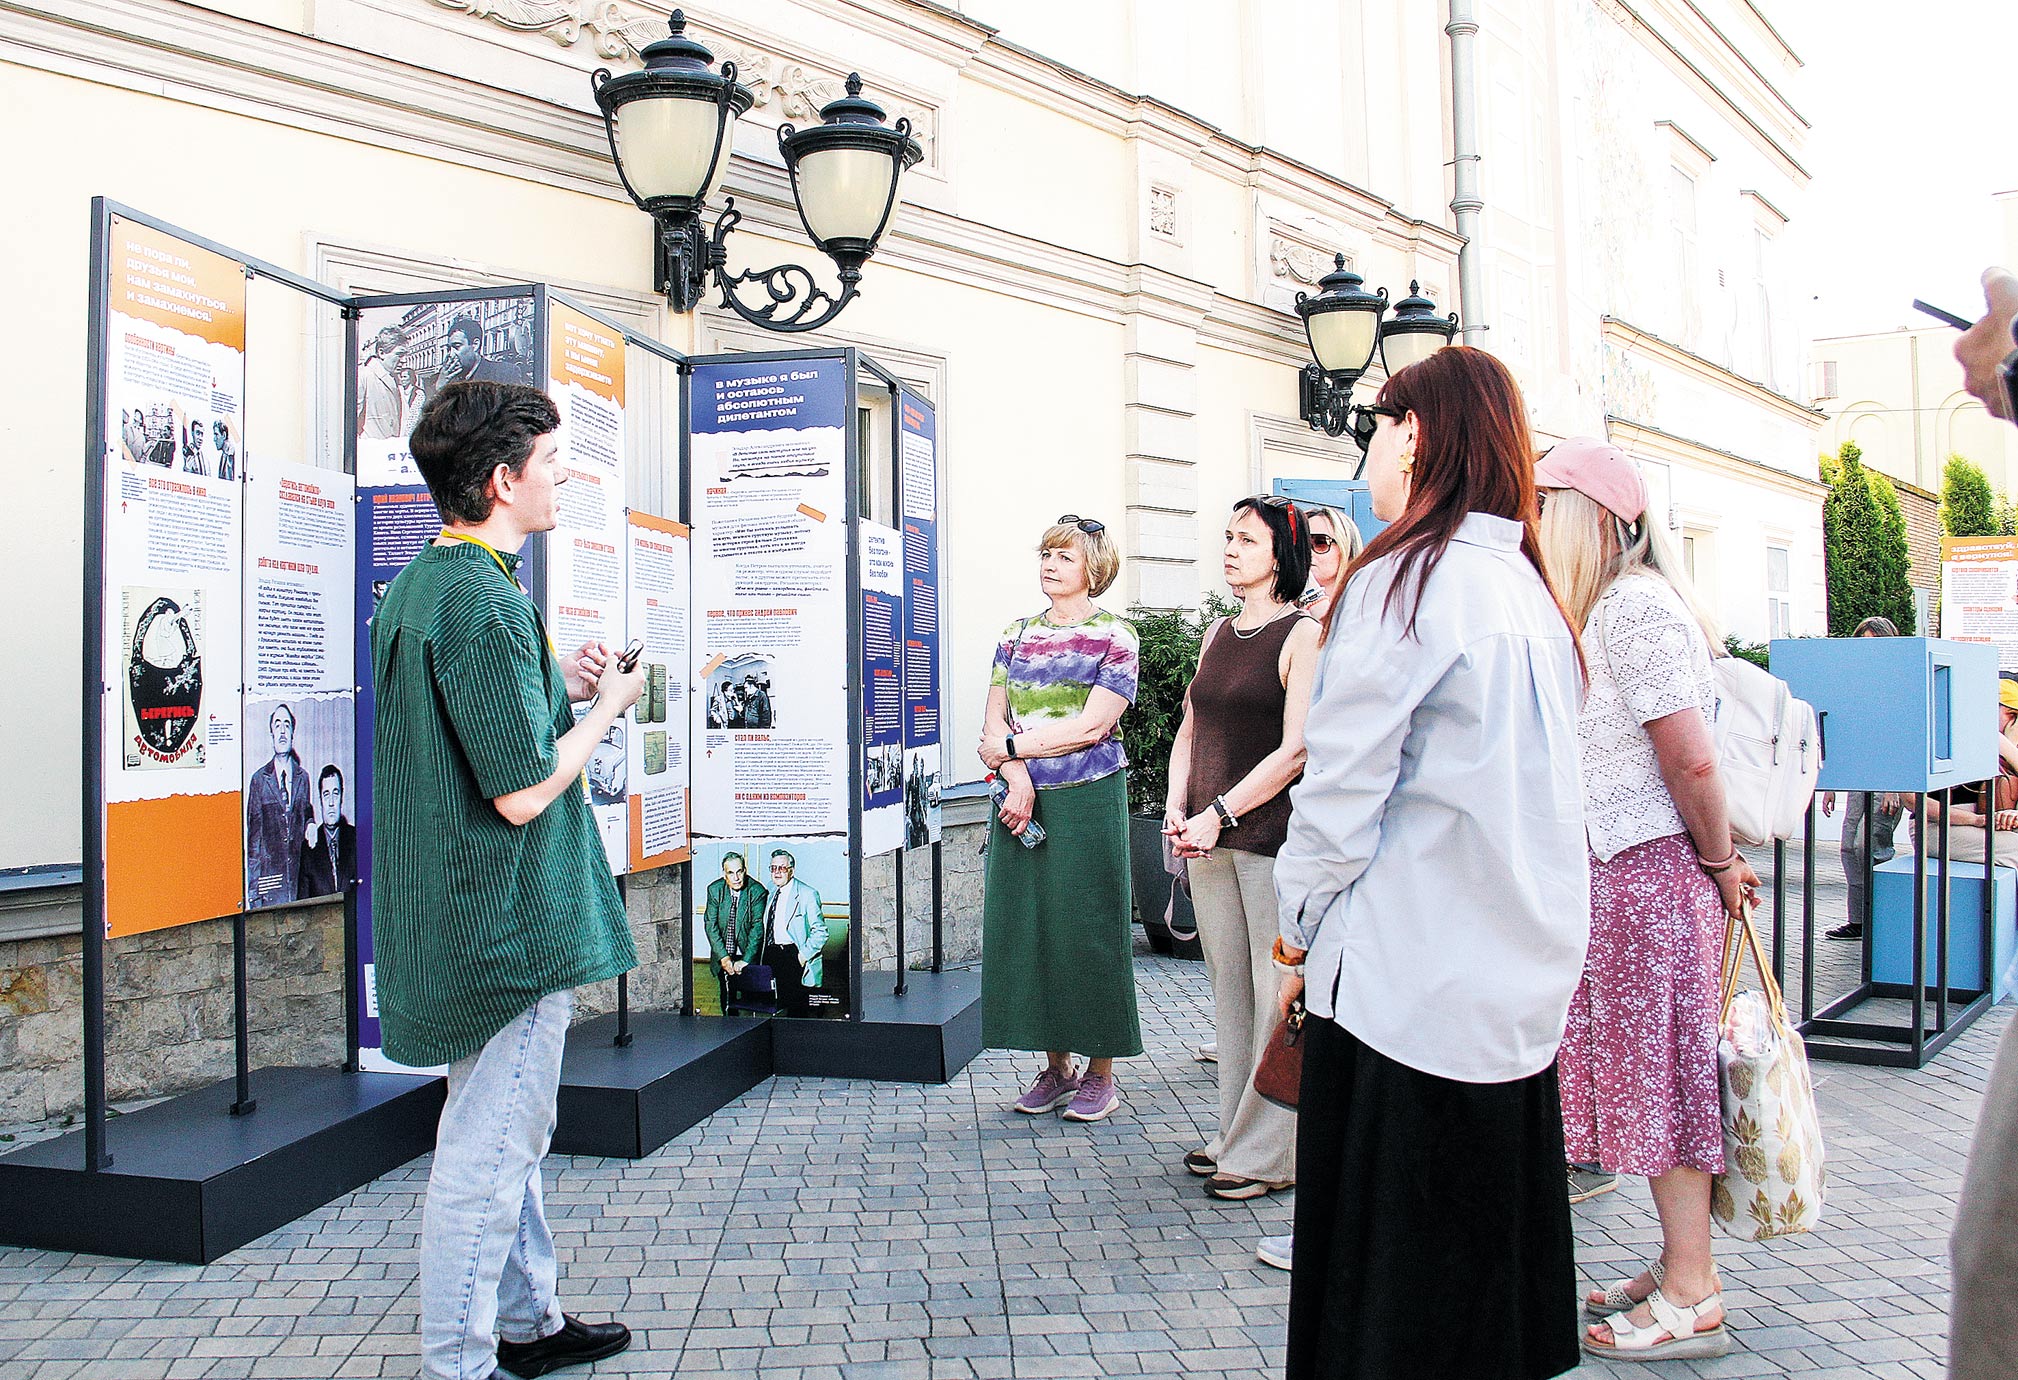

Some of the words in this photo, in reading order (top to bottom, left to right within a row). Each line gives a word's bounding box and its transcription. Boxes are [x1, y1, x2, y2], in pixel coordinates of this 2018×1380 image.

[126, 241, 142, 253] не
[143, 246, 173, 264] пора
[174, 257, 193, 271] ли,
[126, 257, 170, 279] друзья
[171, 270, 197, 289] мои,
[126, 273, 151, 289] нам
[152, 281, 236, 314] замахнуться...
[126, 289, 135, 301] и
[715, 380, 724, 389] в
[725, 376, 778, 389] музыке
[779, 373, 788, 382] я
[790, 370, 818, 381] был
[716, 391, 725, 400] и
[726, 386, 785, 400] остаюсь
[716, 395, 805, 412] абсолютным
[717, 407, 797, 424] дилетантом
[388, 453, 396, 461] я
[707, 610, 726, 618] первое,
[726, 609, 735, 617] что
[736, 609, 754, 618] принес
[755, 608, 773, 617] андрей
[734, 734, 747, 742] стал
[747, 734, 754, 742] ли
[754, 734, 772, 743] вальс,
[133, 732, 198, 764] АВТОМОБИЛЯ
[734, 793, 741, 801] ни
[746, 793, 762, 801] одним
[763, 793, 770, 801] из
[770, 793, 807, 802] композиторов
